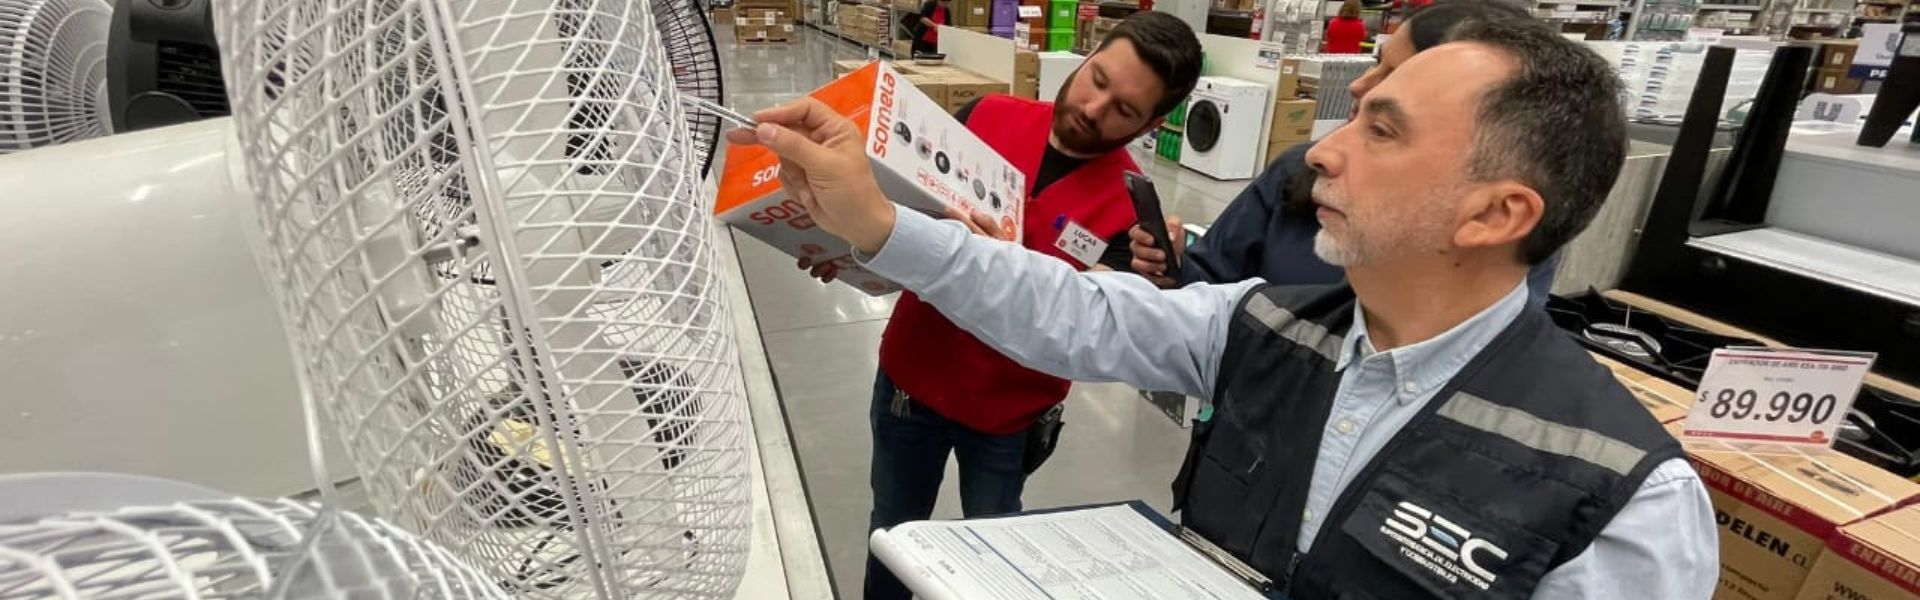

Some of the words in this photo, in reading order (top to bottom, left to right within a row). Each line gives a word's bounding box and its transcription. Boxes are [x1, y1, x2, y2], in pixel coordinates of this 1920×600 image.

[873, 72, 896, 159] somela
[1699, 390, 1710, 402] $
[1710, 388, 1837, 425] 89.990
[1385, 501, 1509, 583] SEC
